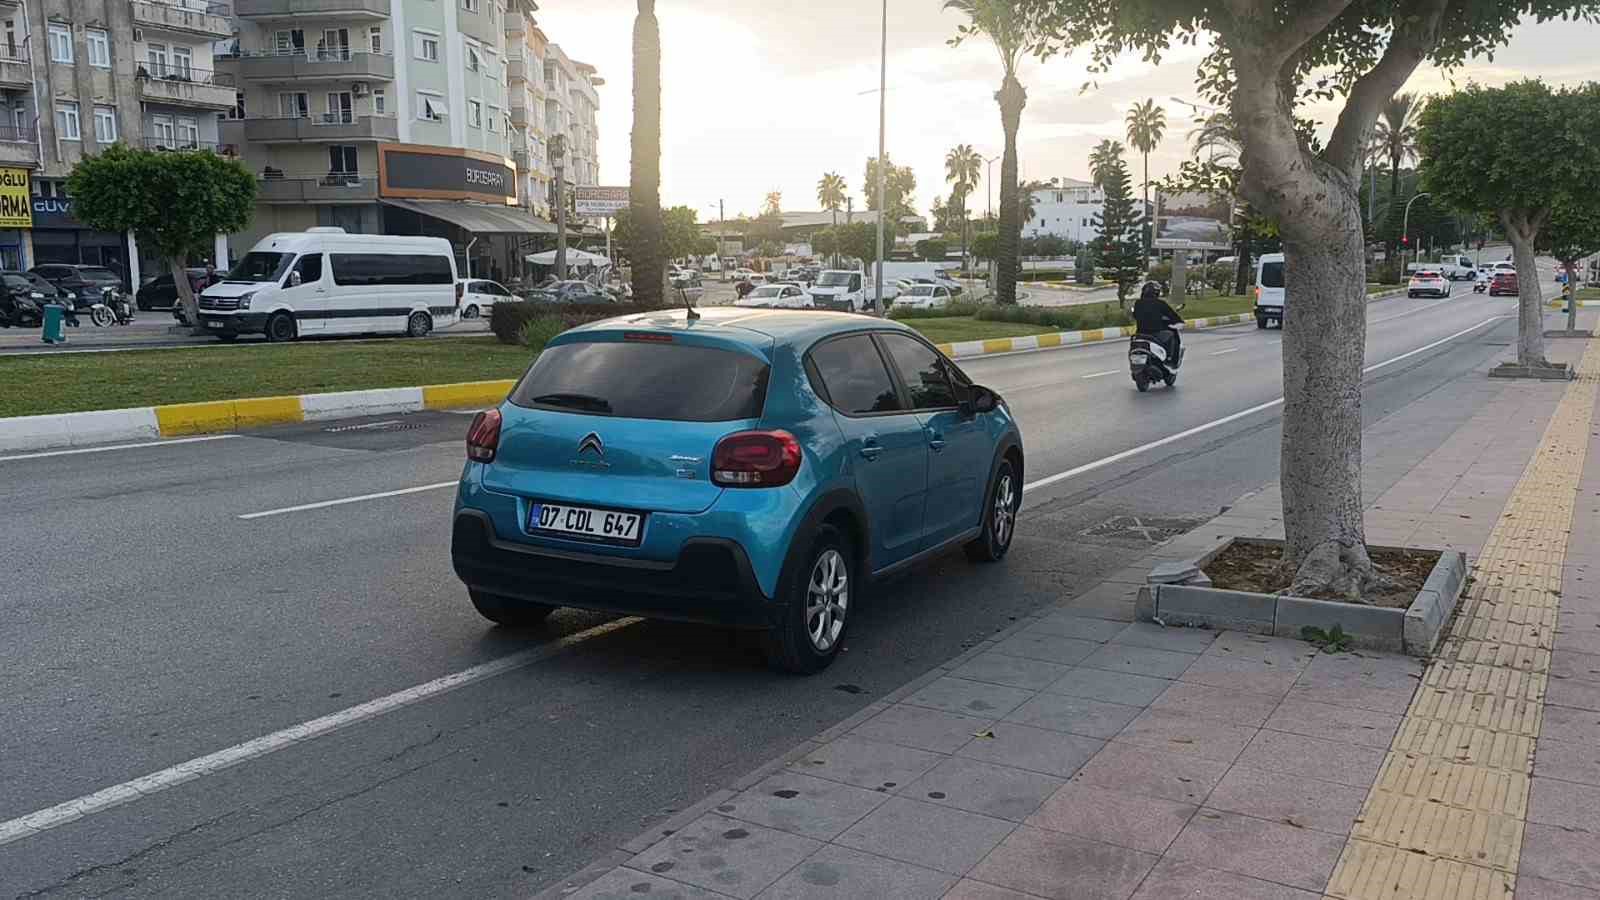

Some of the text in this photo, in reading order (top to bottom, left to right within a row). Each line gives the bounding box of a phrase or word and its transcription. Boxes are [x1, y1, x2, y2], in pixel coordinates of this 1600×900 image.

[0, 195, 30, 217] RMA
[540, 506, 638, 536] 07 CDL 647
